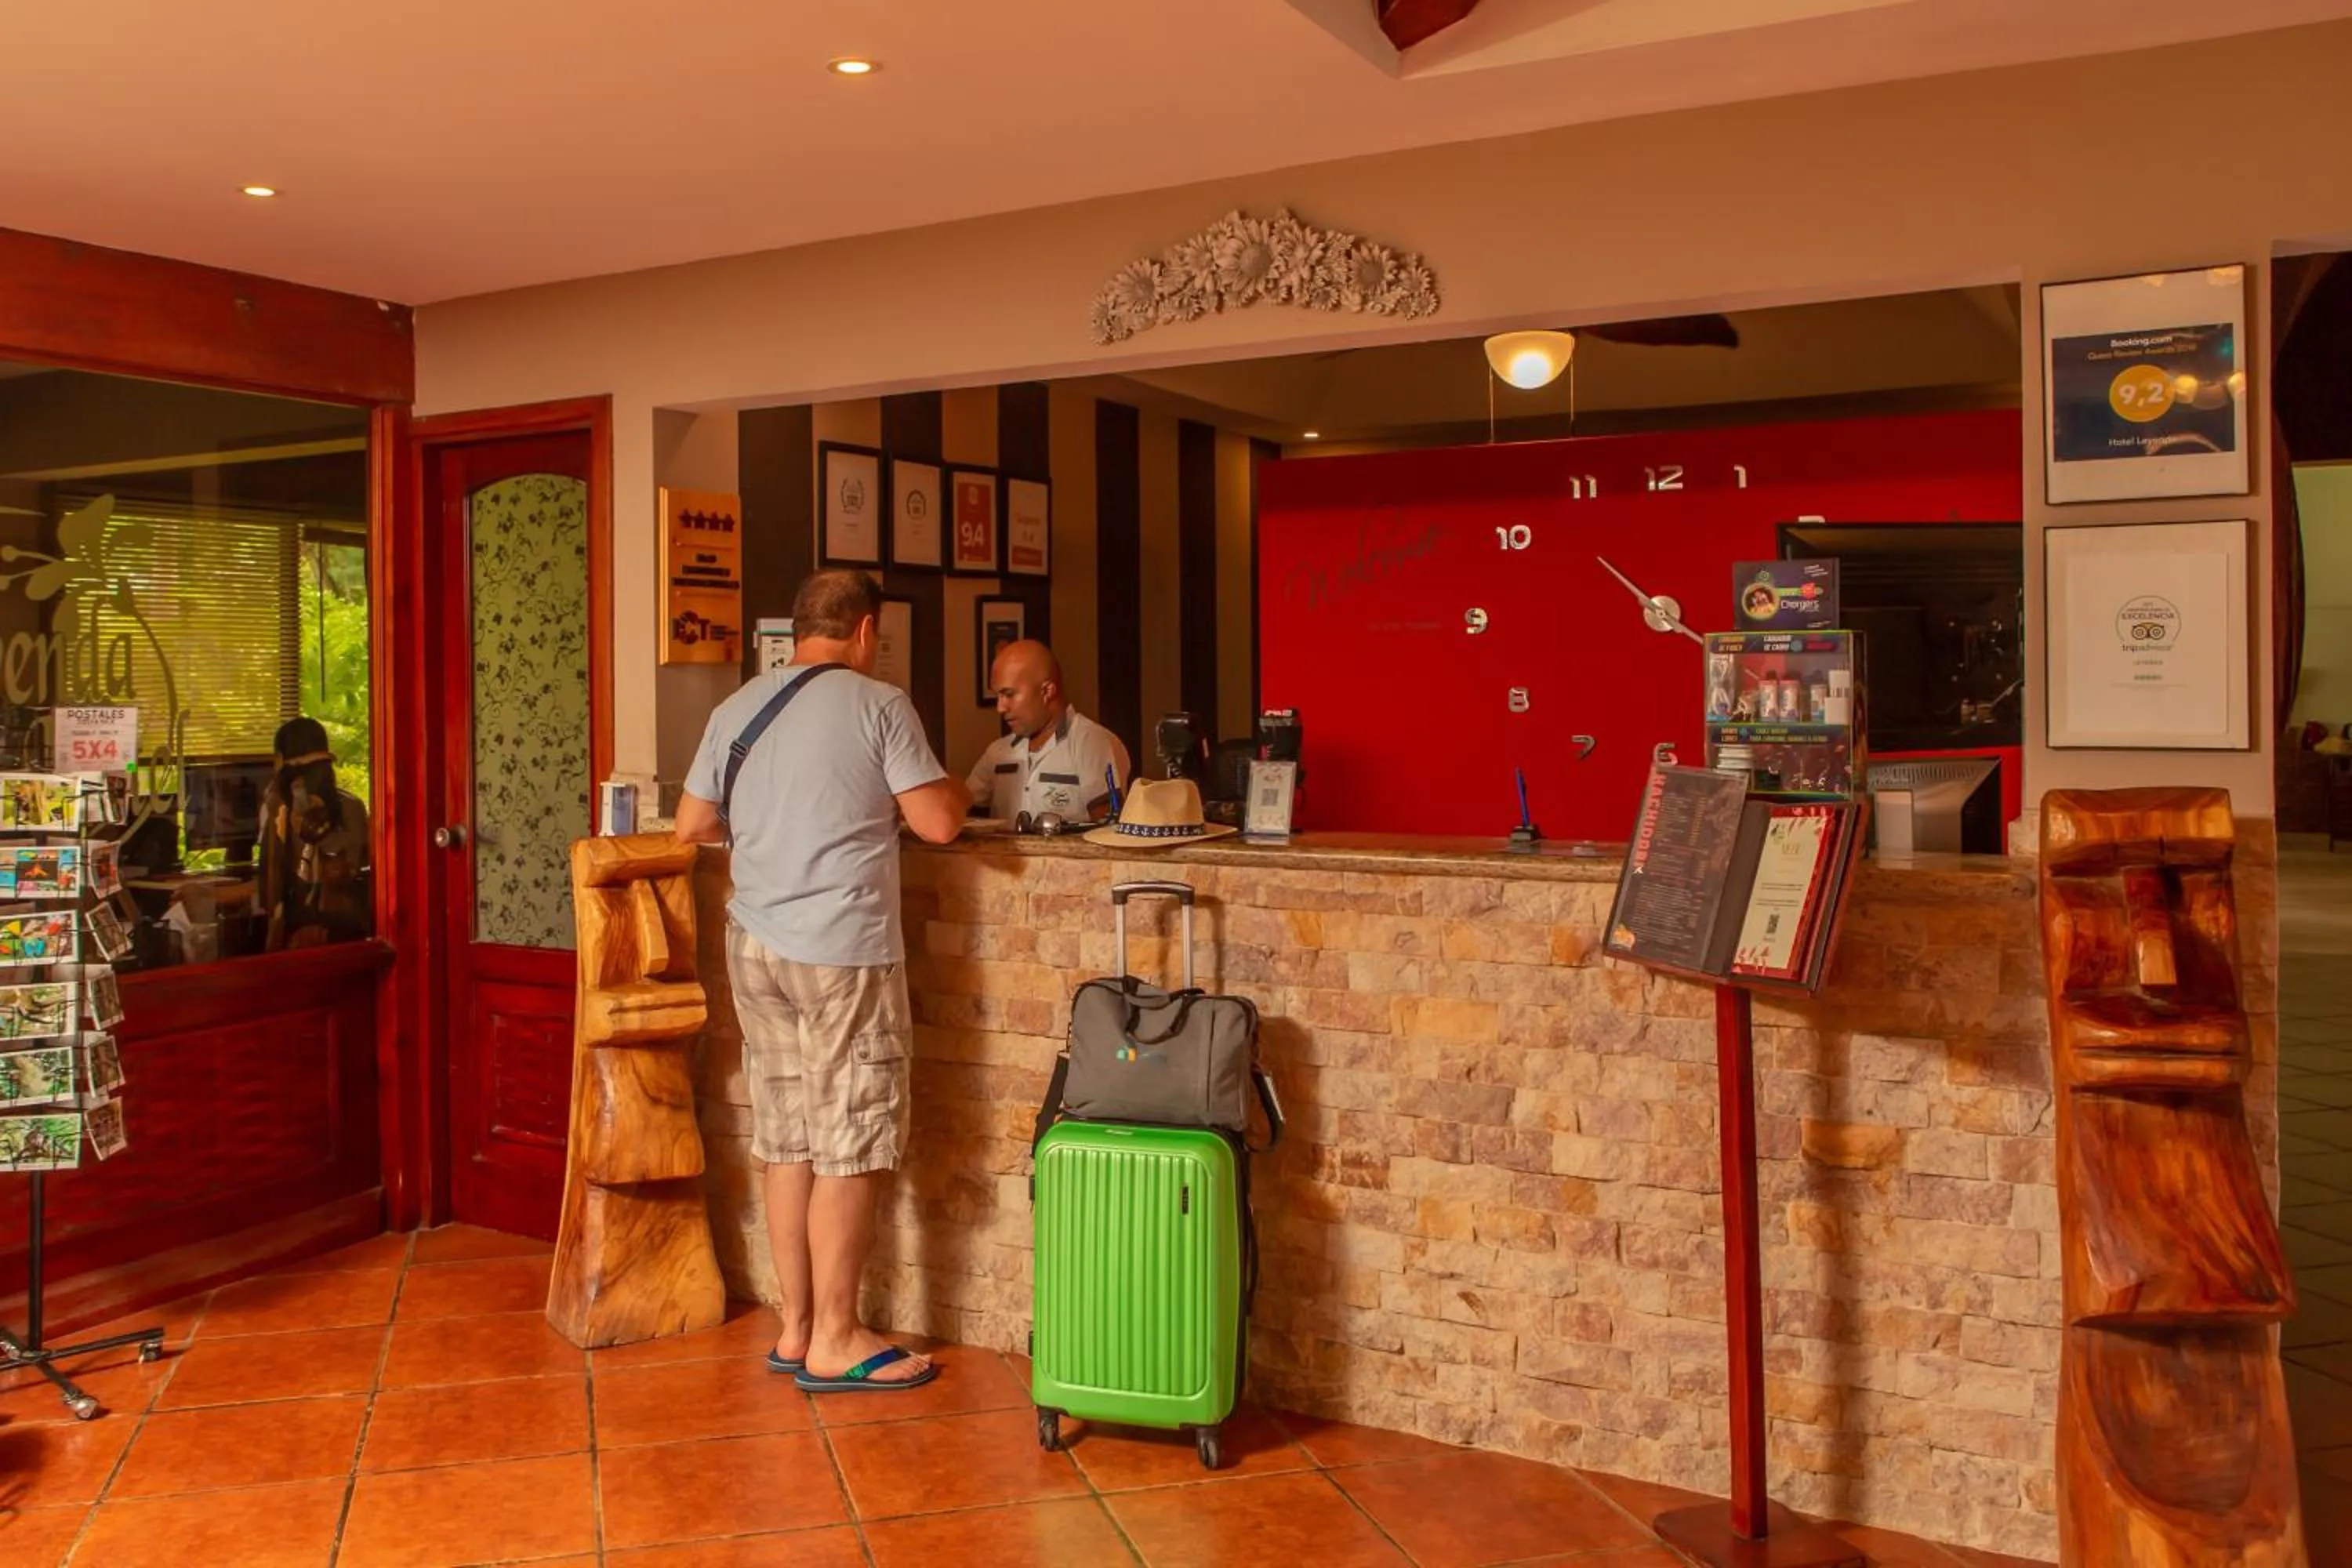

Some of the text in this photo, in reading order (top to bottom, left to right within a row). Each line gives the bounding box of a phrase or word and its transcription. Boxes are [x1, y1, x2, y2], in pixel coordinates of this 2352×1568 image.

[2110, 336, 2172, 348] Booking.com
[2118, 383, 2164, 407] 9,2
[2109, 436, 2135, 446] Hotel
[1570, 474, 1598, 499] 11
[1644, 466, 1683, 491] 12
[1733, 465, 1748, 489] 1
[961, 521, 985, 547] 94
[1495, 524, 1532, 550] 10
[1465, 608, 1488, 633] 9
[1508, 687, 1530, 713] 8
[67, 710, 125, 719] POSTALES
[1571, 735, 1595, 760] 7
